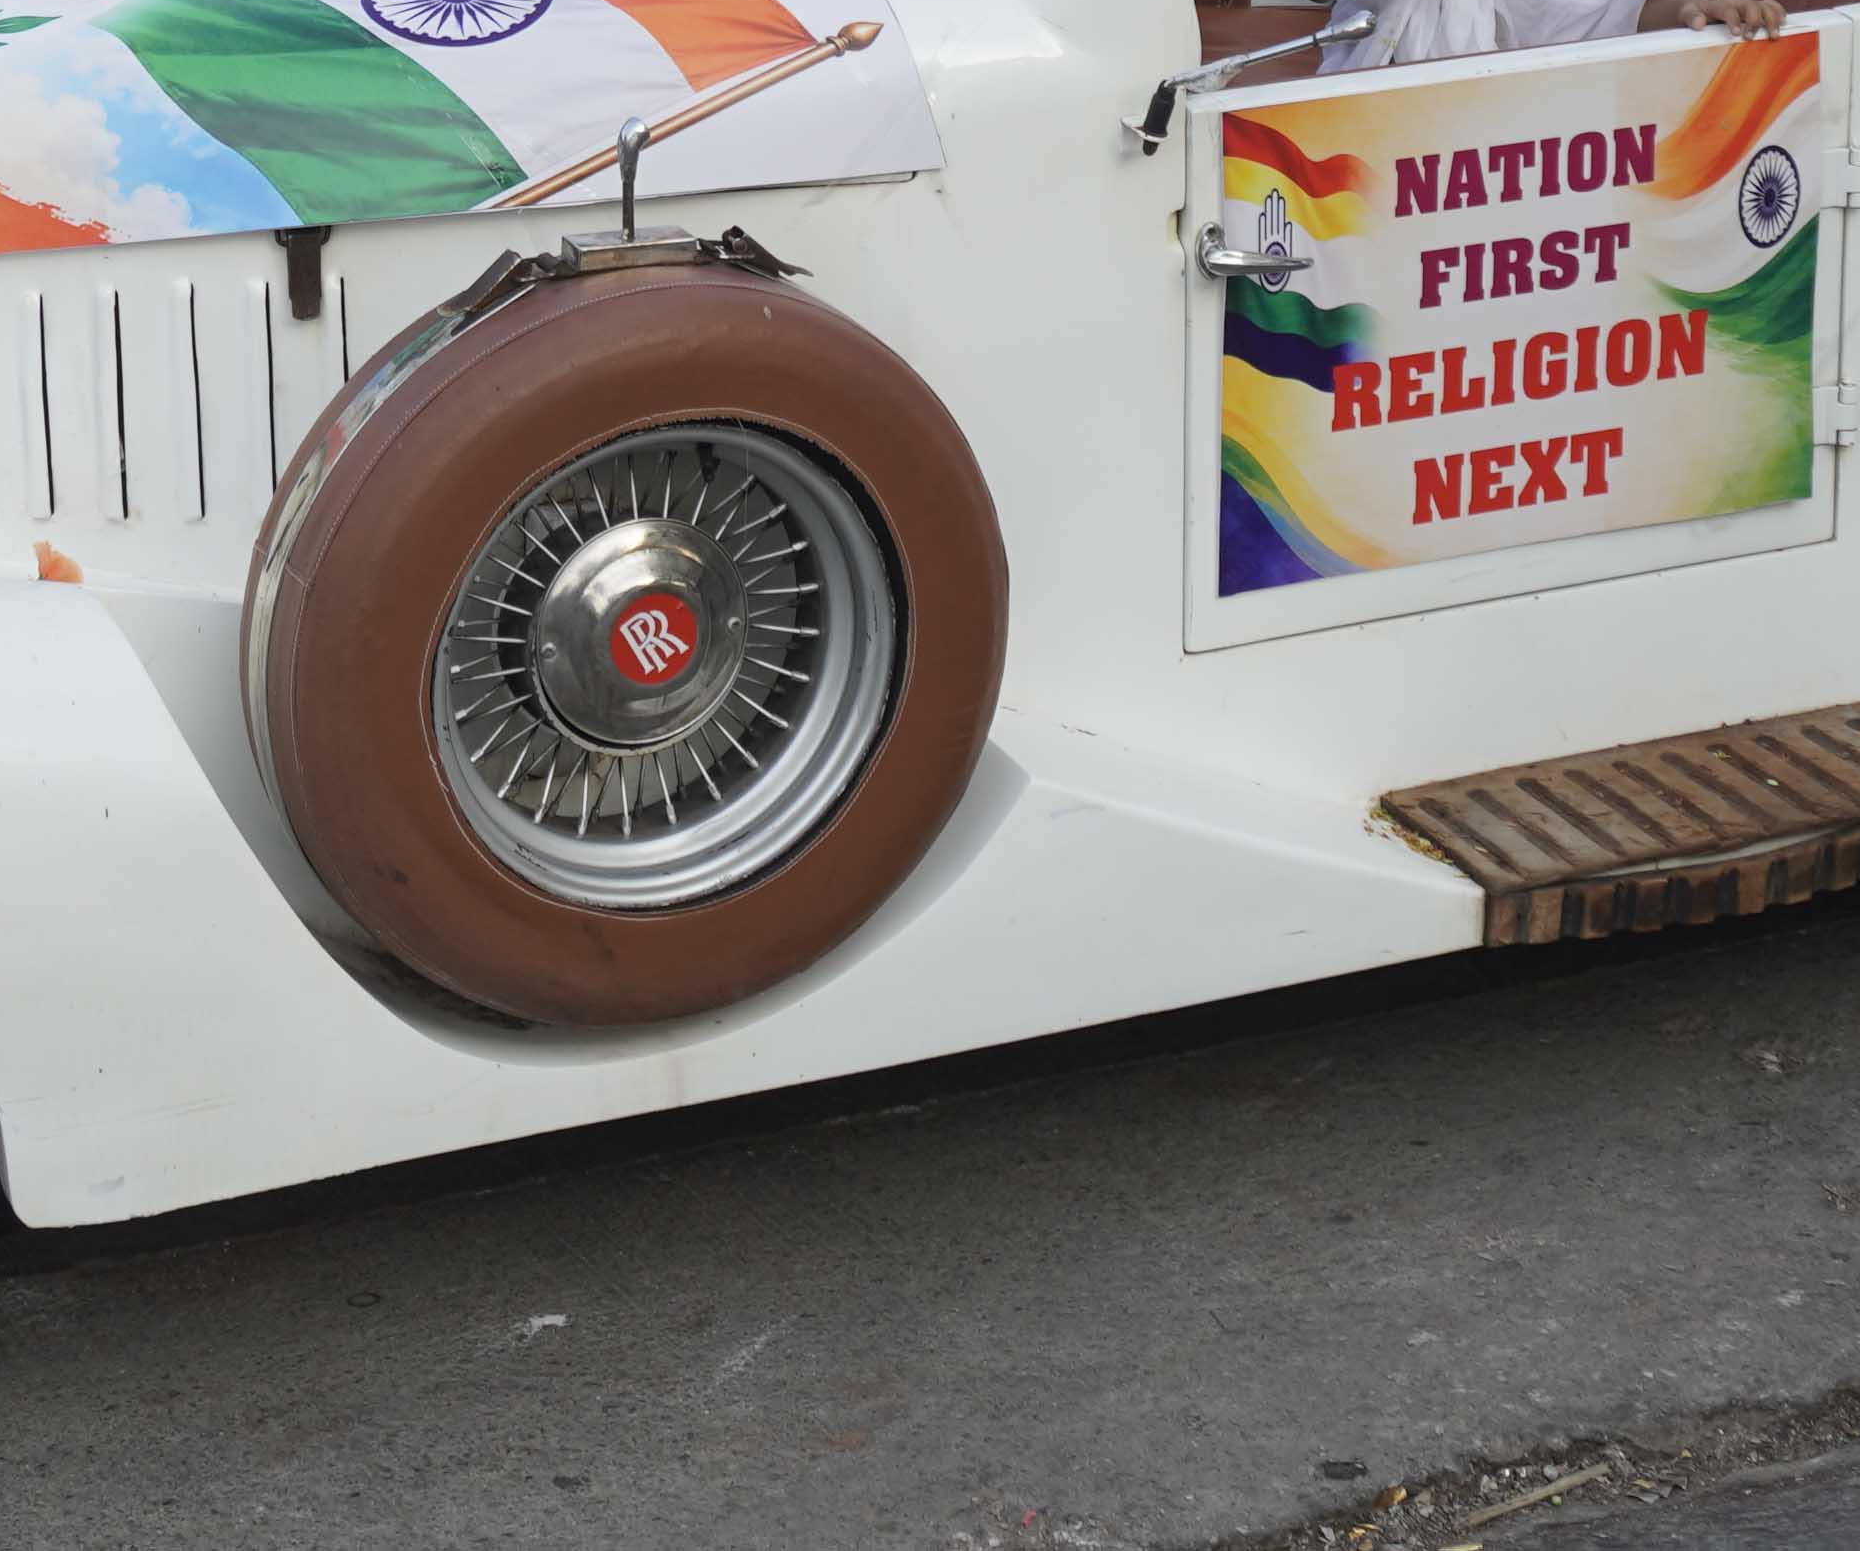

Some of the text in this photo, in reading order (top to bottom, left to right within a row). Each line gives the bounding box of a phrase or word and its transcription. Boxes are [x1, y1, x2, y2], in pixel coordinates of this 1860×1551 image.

[1393, 123, 1658, 219] NATION
[1418, 222, 1632, 310] FIRST
[1330, 308, 1710, 433] RELIGION
[1412, 427, 1624, 526] NEXT
